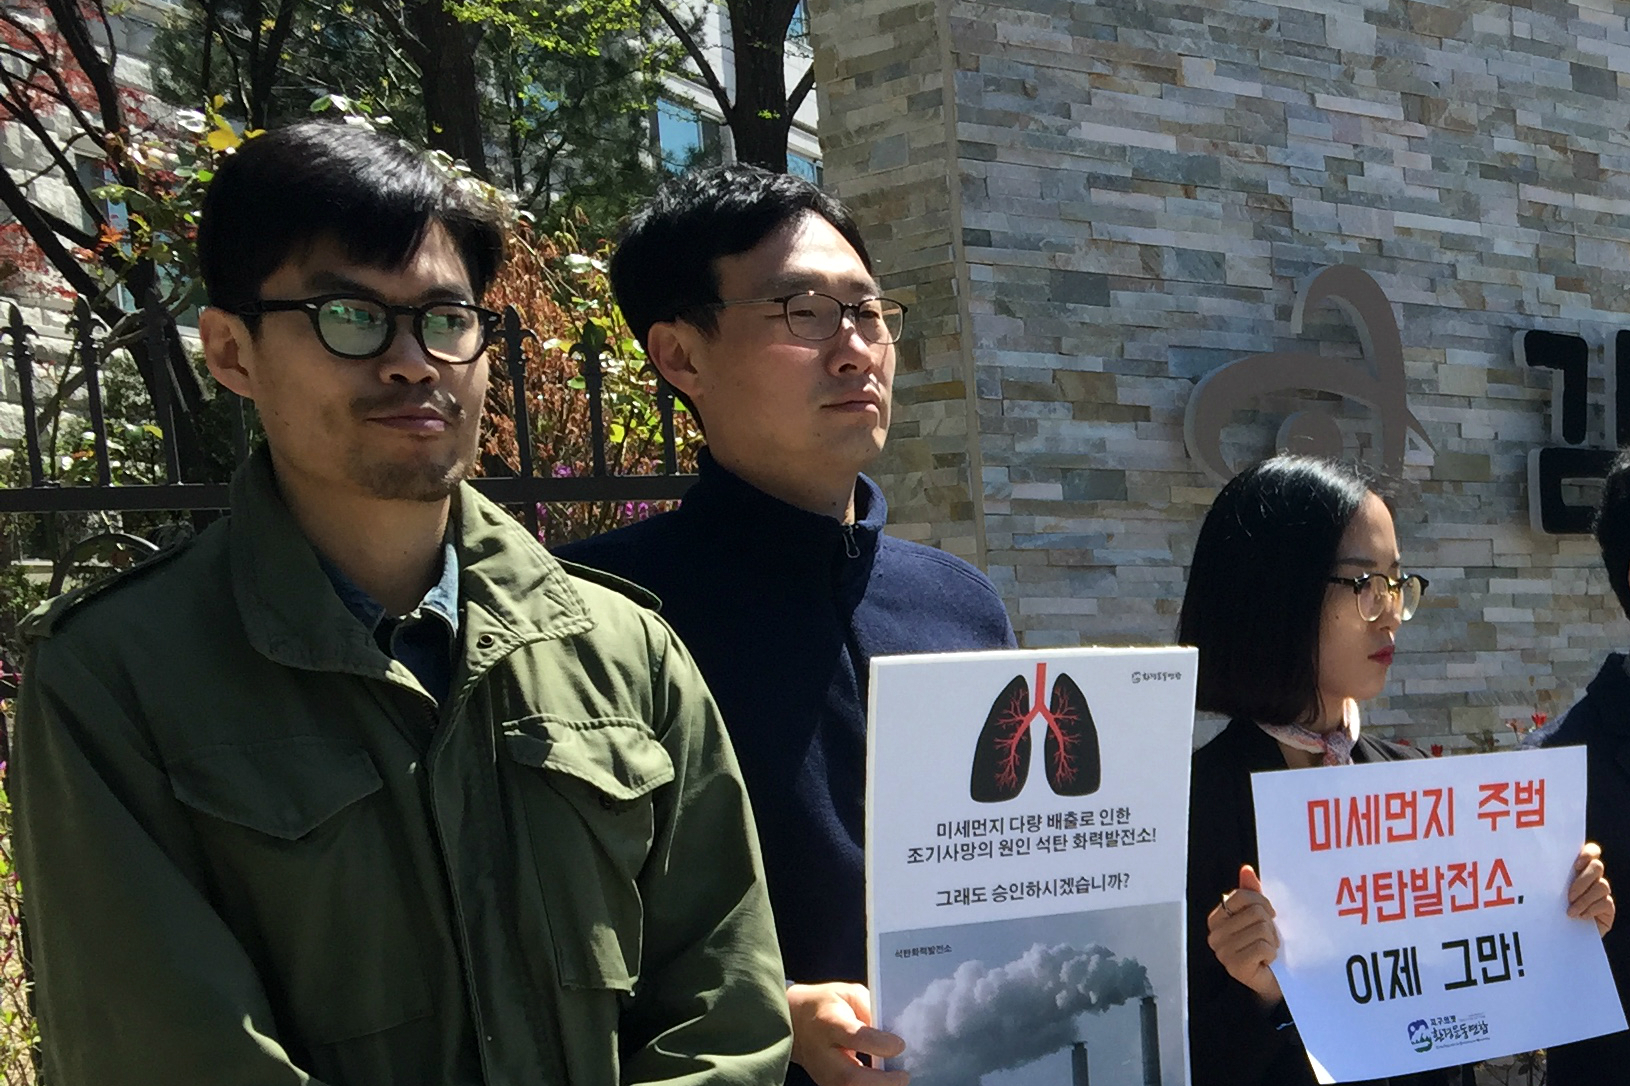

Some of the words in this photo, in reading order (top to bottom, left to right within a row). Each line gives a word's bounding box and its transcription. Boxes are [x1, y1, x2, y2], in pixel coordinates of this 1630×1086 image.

[937, 817, 1004, 839] 미세먼지
[1010, 814, 1042, 833] 다량
[1047, 811, 1095, 830] 배출로
[1100, 807, 1130, 826] 인한
[1307, 787, 1453, 852] 미세먼지
[1478, 779, 1544, 831] 주범
[907, 841, 992, 864] 조기사망의
[998, 837, 1030, 857] 원인
[1036, 834, 1068, 853] 석탄
[1073, 828, 1156, 850] 화력발전소!
[936, 887, 987, 906] 그래도
[992, 873, 1129, 902] 승인하시겠습니까?
[1336, 859, 1524, 924] 석탄발전소,
[894, 943, 952, 958] 석탄화력발전소
[1346, 948, 1422, 1004] 이제
[1442, 932, 1524, 990] 그만!
